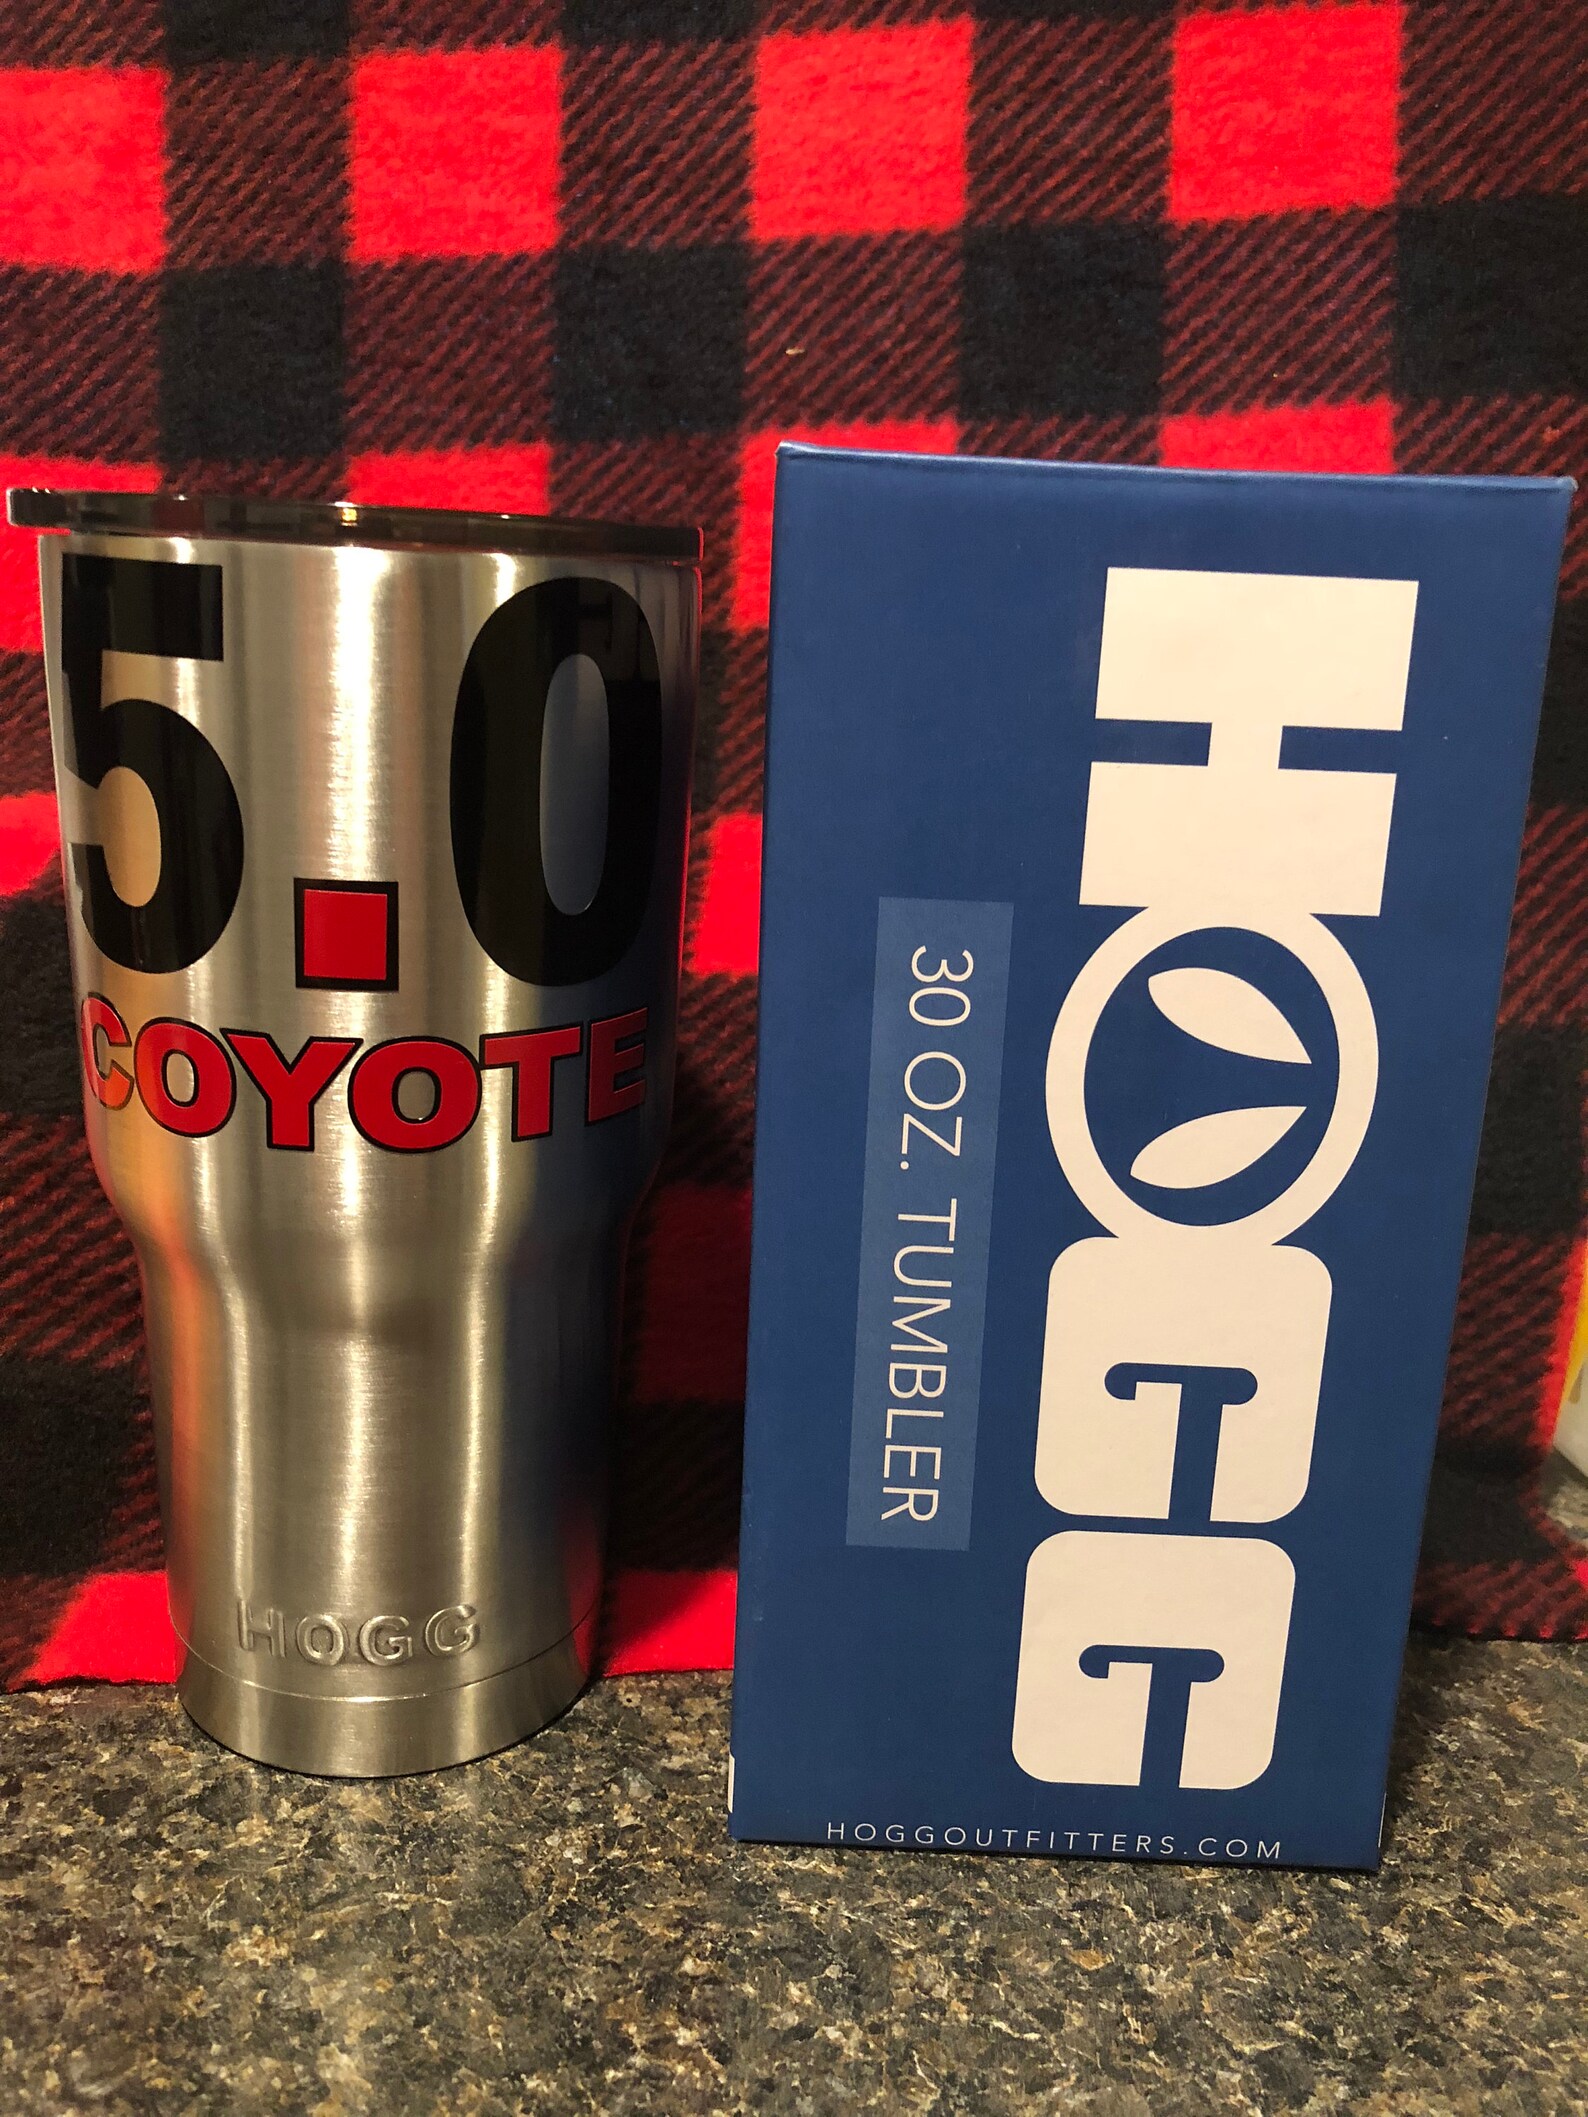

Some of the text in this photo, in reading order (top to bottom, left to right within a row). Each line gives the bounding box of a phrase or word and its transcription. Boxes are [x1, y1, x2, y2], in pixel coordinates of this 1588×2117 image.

[62, 553, 663, 992] 5.0
[82, 993, 649, 1152] COYOTE
[1011, 566, 1420, 1791] HOGG
[881, 945, 975, 1522] 30 OZ. TUMBLER
[236, 1598, 482, 1667] HOGG
[826, 1821, 1283, 1860] HOGGOUTFITTERS.COM
